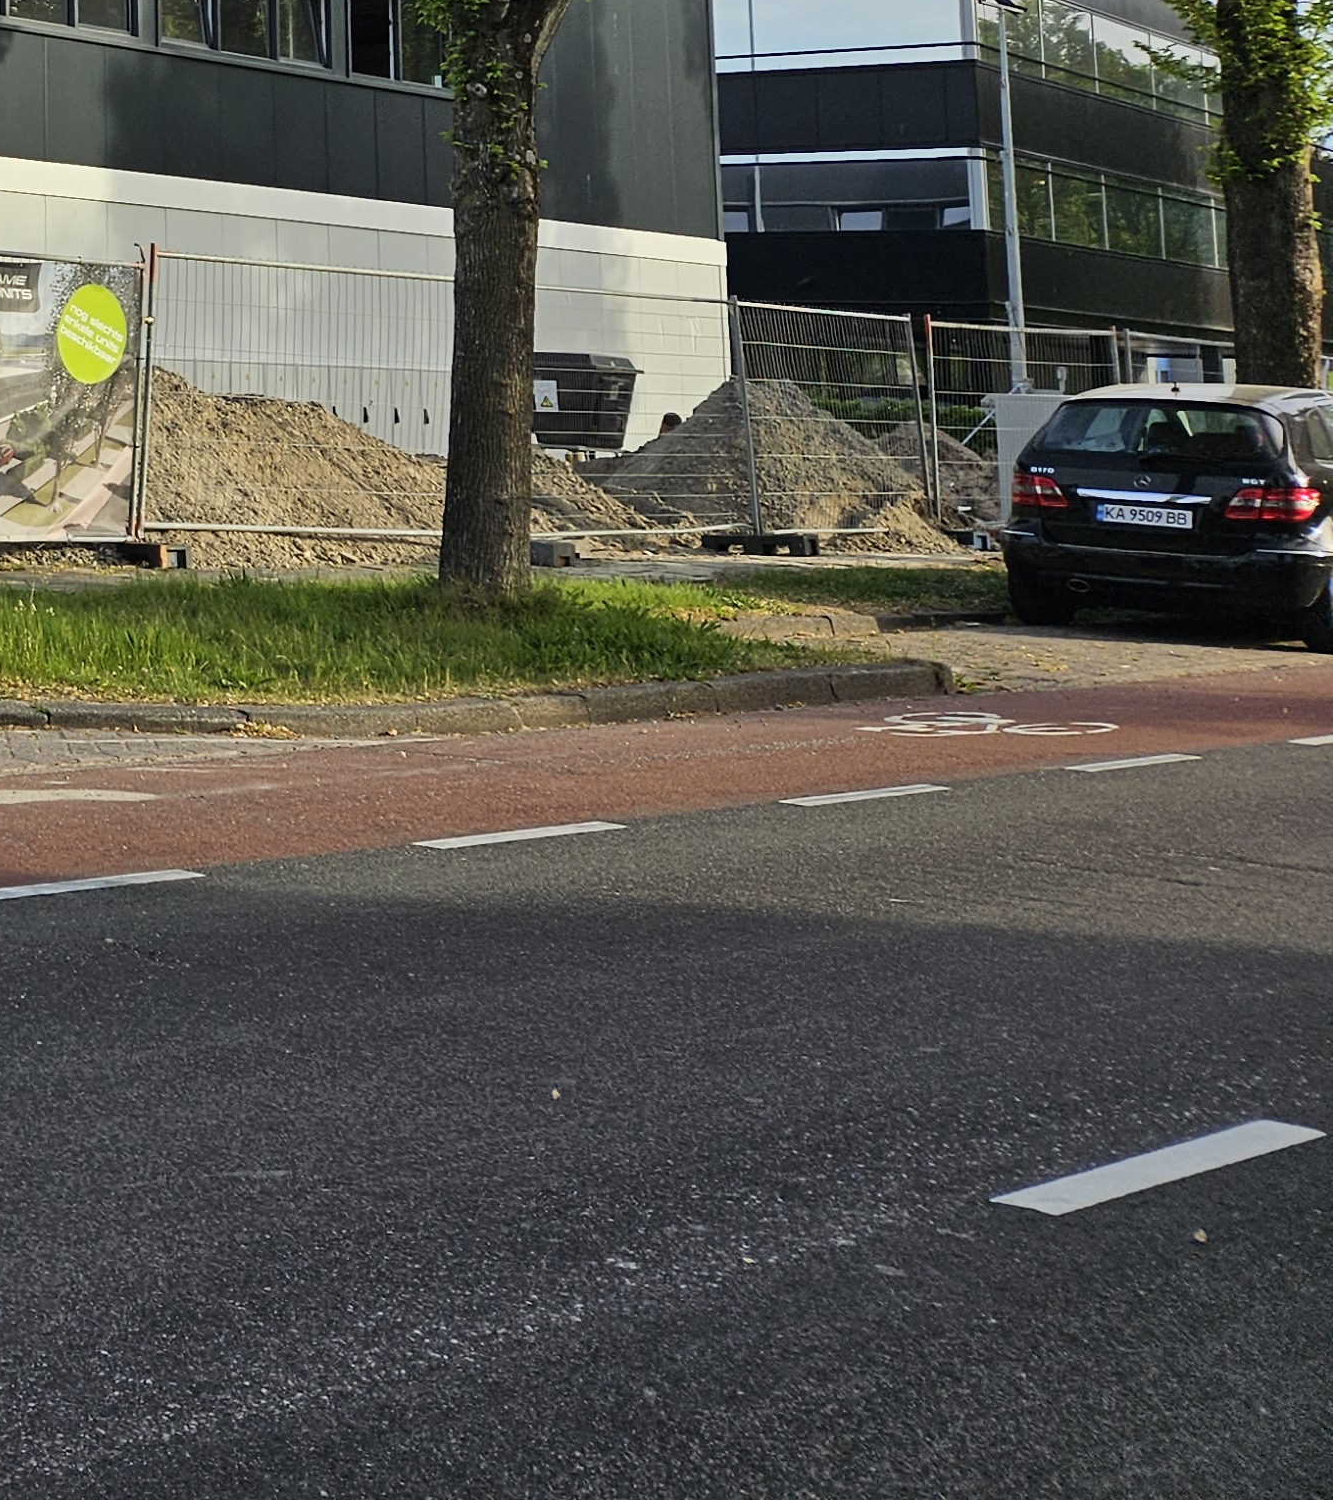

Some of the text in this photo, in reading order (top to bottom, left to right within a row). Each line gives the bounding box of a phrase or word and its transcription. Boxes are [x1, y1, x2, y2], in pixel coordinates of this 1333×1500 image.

[64, 314, 120, 354] enkele units
[70, 304, 124, 343] nog slechts
[60, 324, 117, 364] beschikbaar
[1105, 505, 1188, 525] KA 9509 BB
